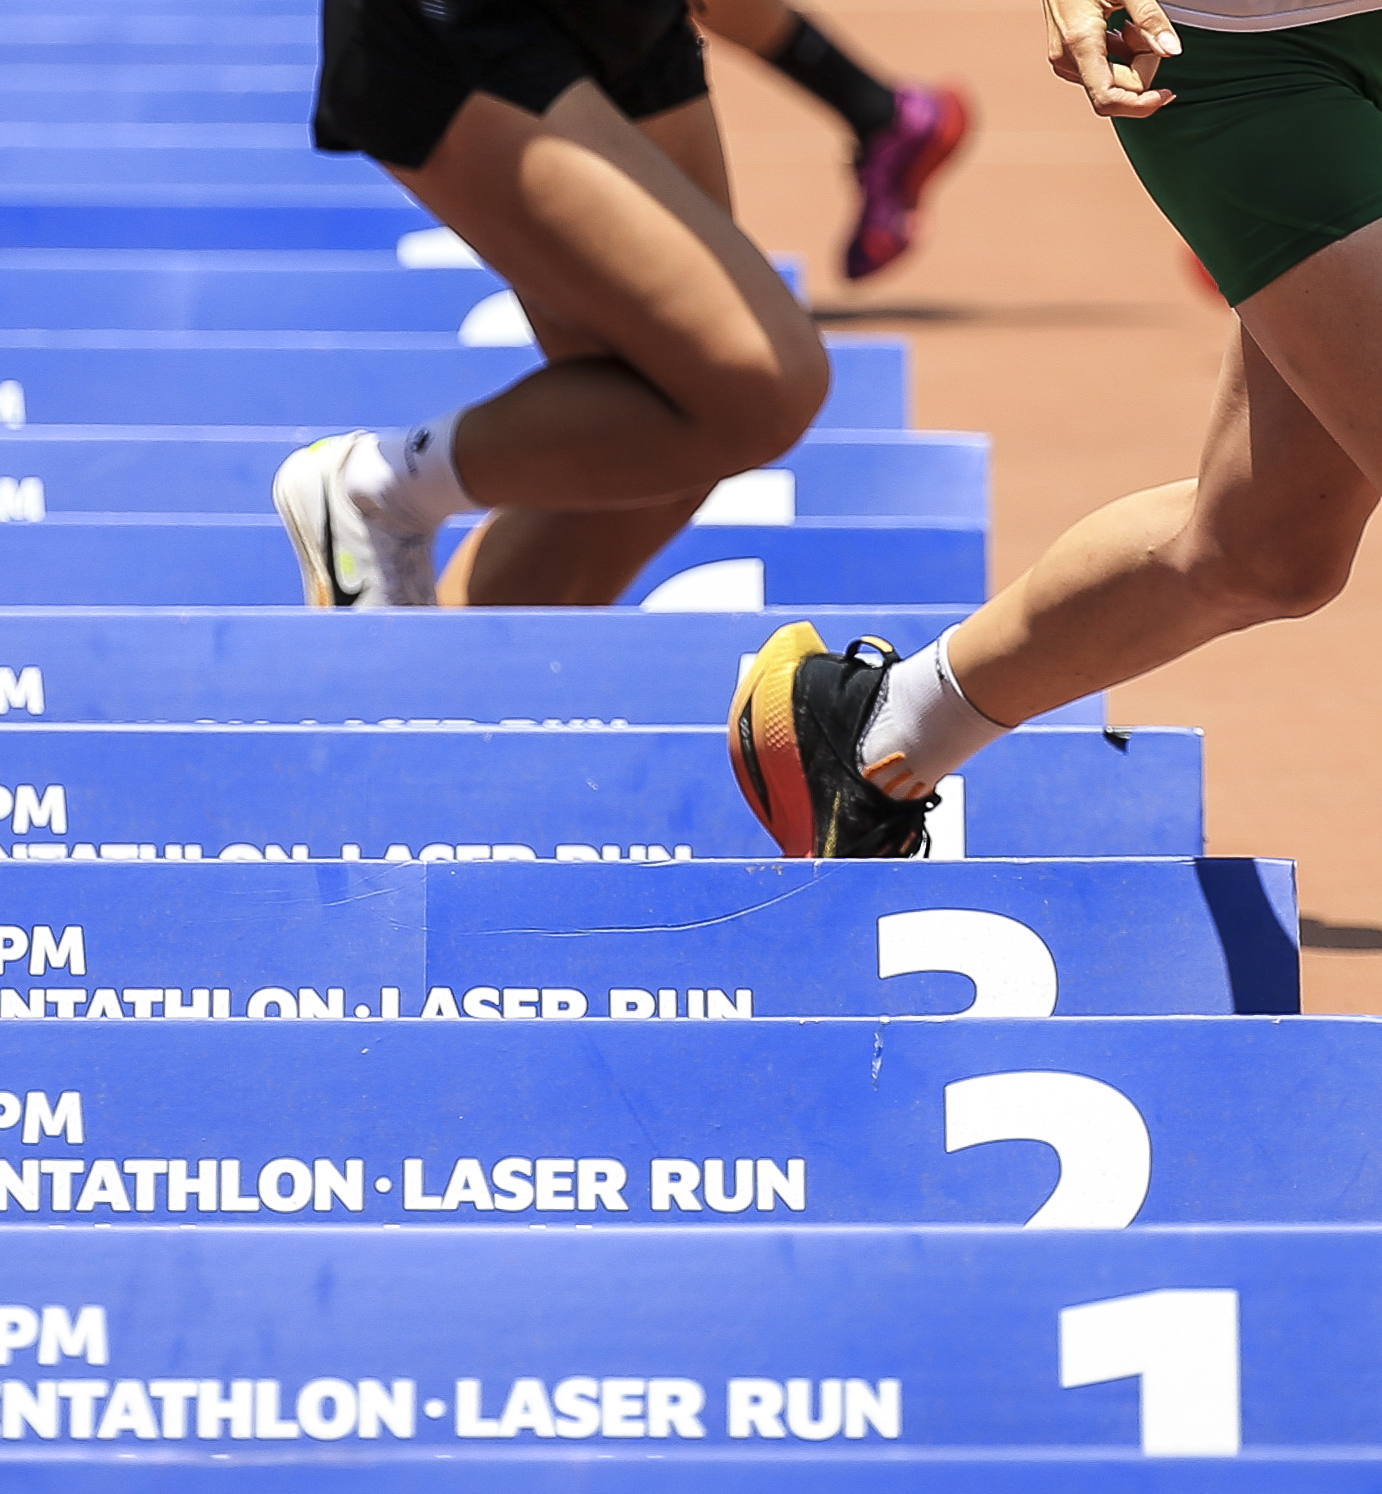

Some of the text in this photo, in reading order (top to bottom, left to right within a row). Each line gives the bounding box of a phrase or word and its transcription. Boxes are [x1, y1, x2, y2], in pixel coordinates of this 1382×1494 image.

[650, 1159, 806, 1212] RUN
[1060, 1289, 1240, 1457] 1
[728, 1378, 901, 1440] RUN
